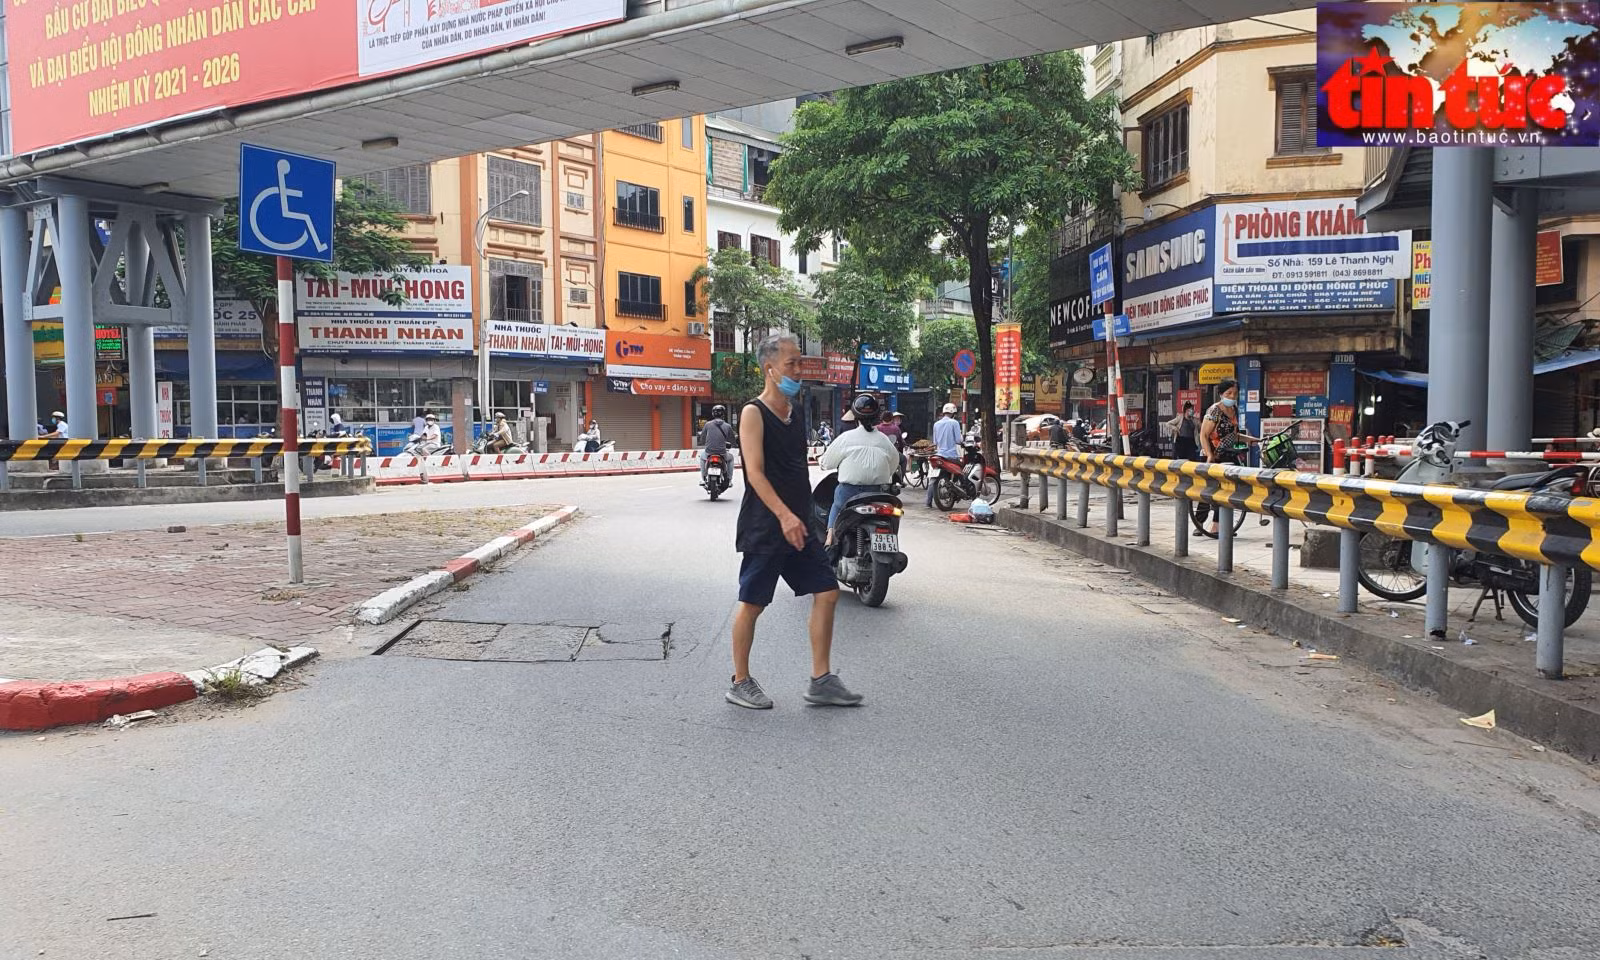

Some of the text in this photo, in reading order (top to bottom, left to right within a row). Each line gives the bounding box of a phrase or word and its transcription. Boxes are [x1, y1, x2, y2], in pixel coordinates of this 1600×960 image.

[45, 1, 69, 40] BẦU
[91, 0, 114, 27] ĐẠI
[29, 56, 46, 88] VÀ
[47, 53, 67, 87] ĐẠI
[70, 35, 98, 77] BIỂU
[101, 32, 123, 71] HỘI
[126, 19, 163, 60] ĐỒNG
[166, 8, 207, 48] NHÂN
[211, 0, 244, 36] DÂN
[89, 79, 130, 117] NHIỆM
[134, 69, 151, 105] KỲ
[154, 65, 188, 100] 2021
[202, 52, 241, 89] 2026
[1235, 204, 1365, 239] PHÒNG KHÁM
[1126, 229, 1206, 283] SAMSUNG
[1267, 257, 1281, 267] Số
[1282, 256, 1304, 267] Nhà:
[1307, 257, 1323, 266] 159
[1325, 256, 1337, 265] Lê
[1339, 255, 1370, 265] Thanh
[1304, 270, 1328, 278] 591811
[1332, 269, 1351, 277] (043)
[1220, 280, 1389, 294] ĐIỆN THOẠI DI ĐỘNG HỒNG PHÚC
[1153, 300, 1159, 315] DI
[238, 310, 257, 320] 25
[308, 326, 464, 340] THANH NHÀN
[494, 324, 542, 334] NHÀ THUỐC
[489, 333, 546, 352] THANH NHÀN
[306, 388, 323, 396] THANH
[640, 381, 653, 391] Cho
[654, 383, 666, 393] vay
[671, 384, 688, 393] đăng
[1299, 408, 1311, 416] SIM
[1314, 406, 1327, 416] THẺ
